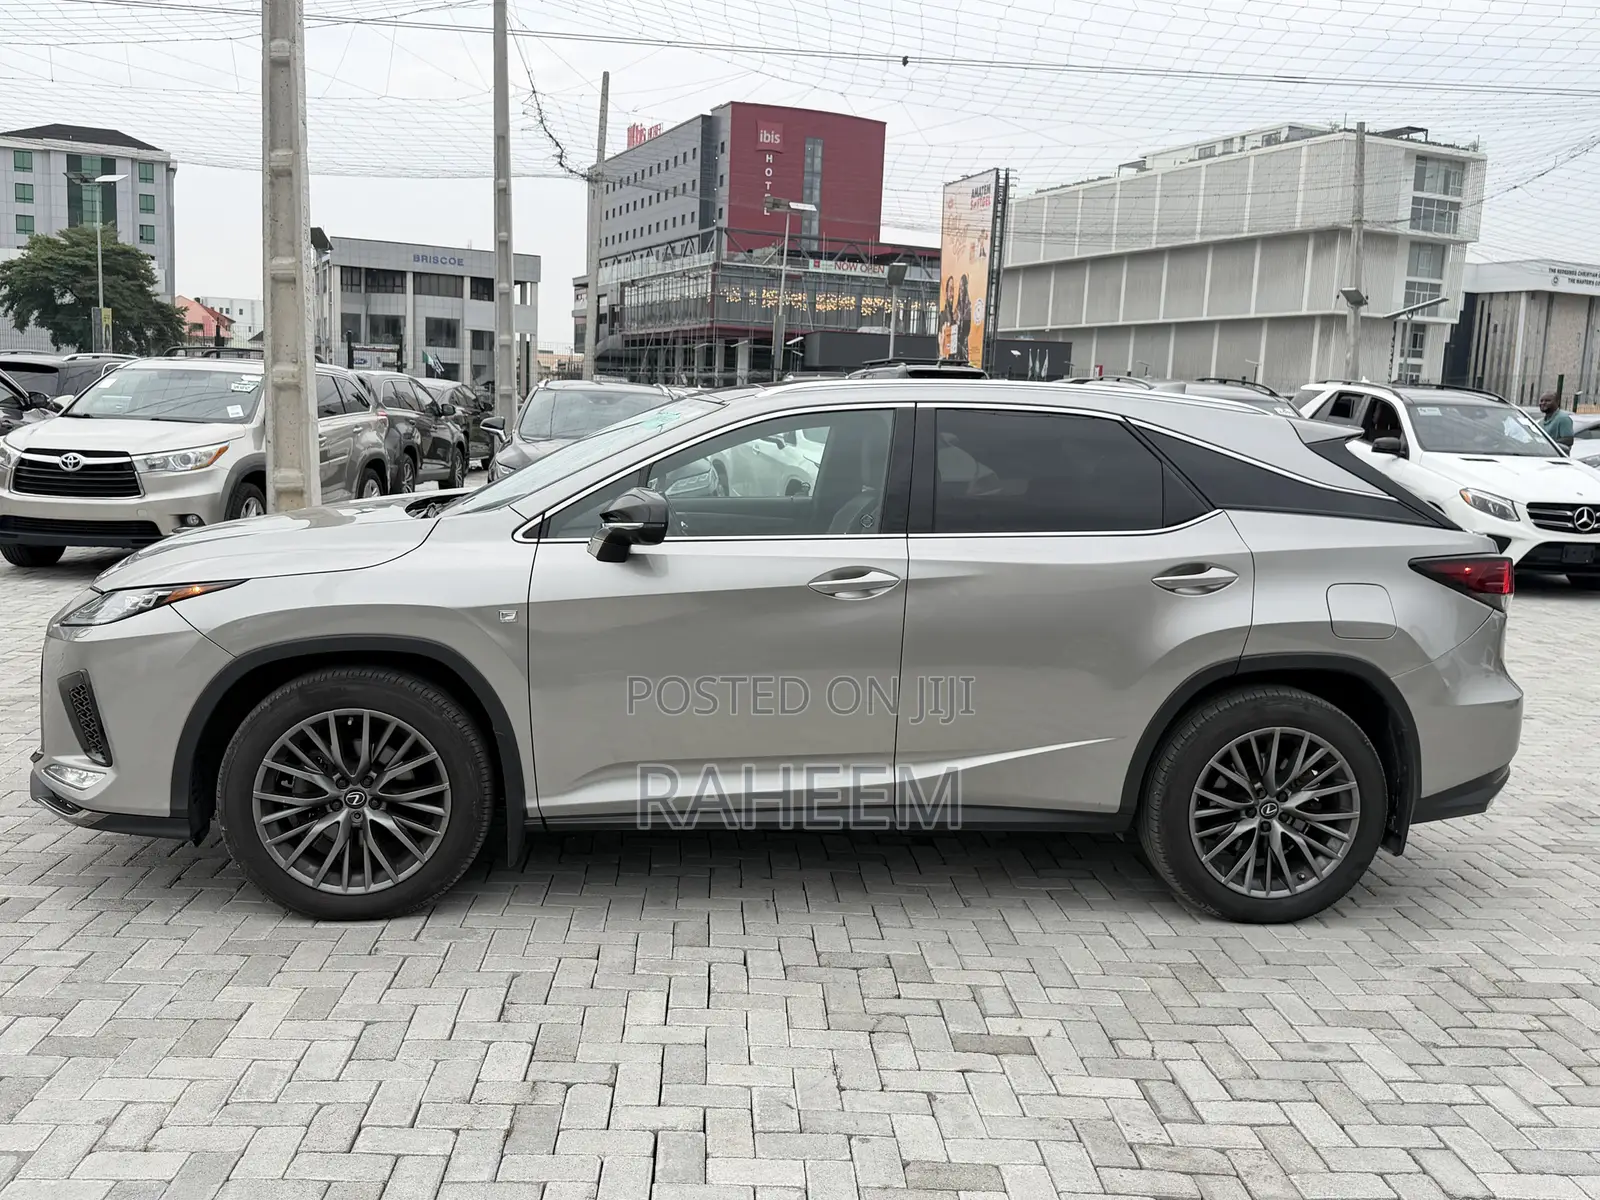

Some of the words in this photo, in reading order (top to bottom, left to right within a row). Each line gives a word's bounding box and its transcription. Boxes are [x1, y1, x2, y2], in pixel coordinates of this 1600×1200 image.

[760, 130, 780, 143] ibis
[763, 154, 773, 216] HOTL
[413, 254, 465, 266] BRISCOE
[835, 262, 858, 271] NOW
[860, 264, 884, 273] OPEN
